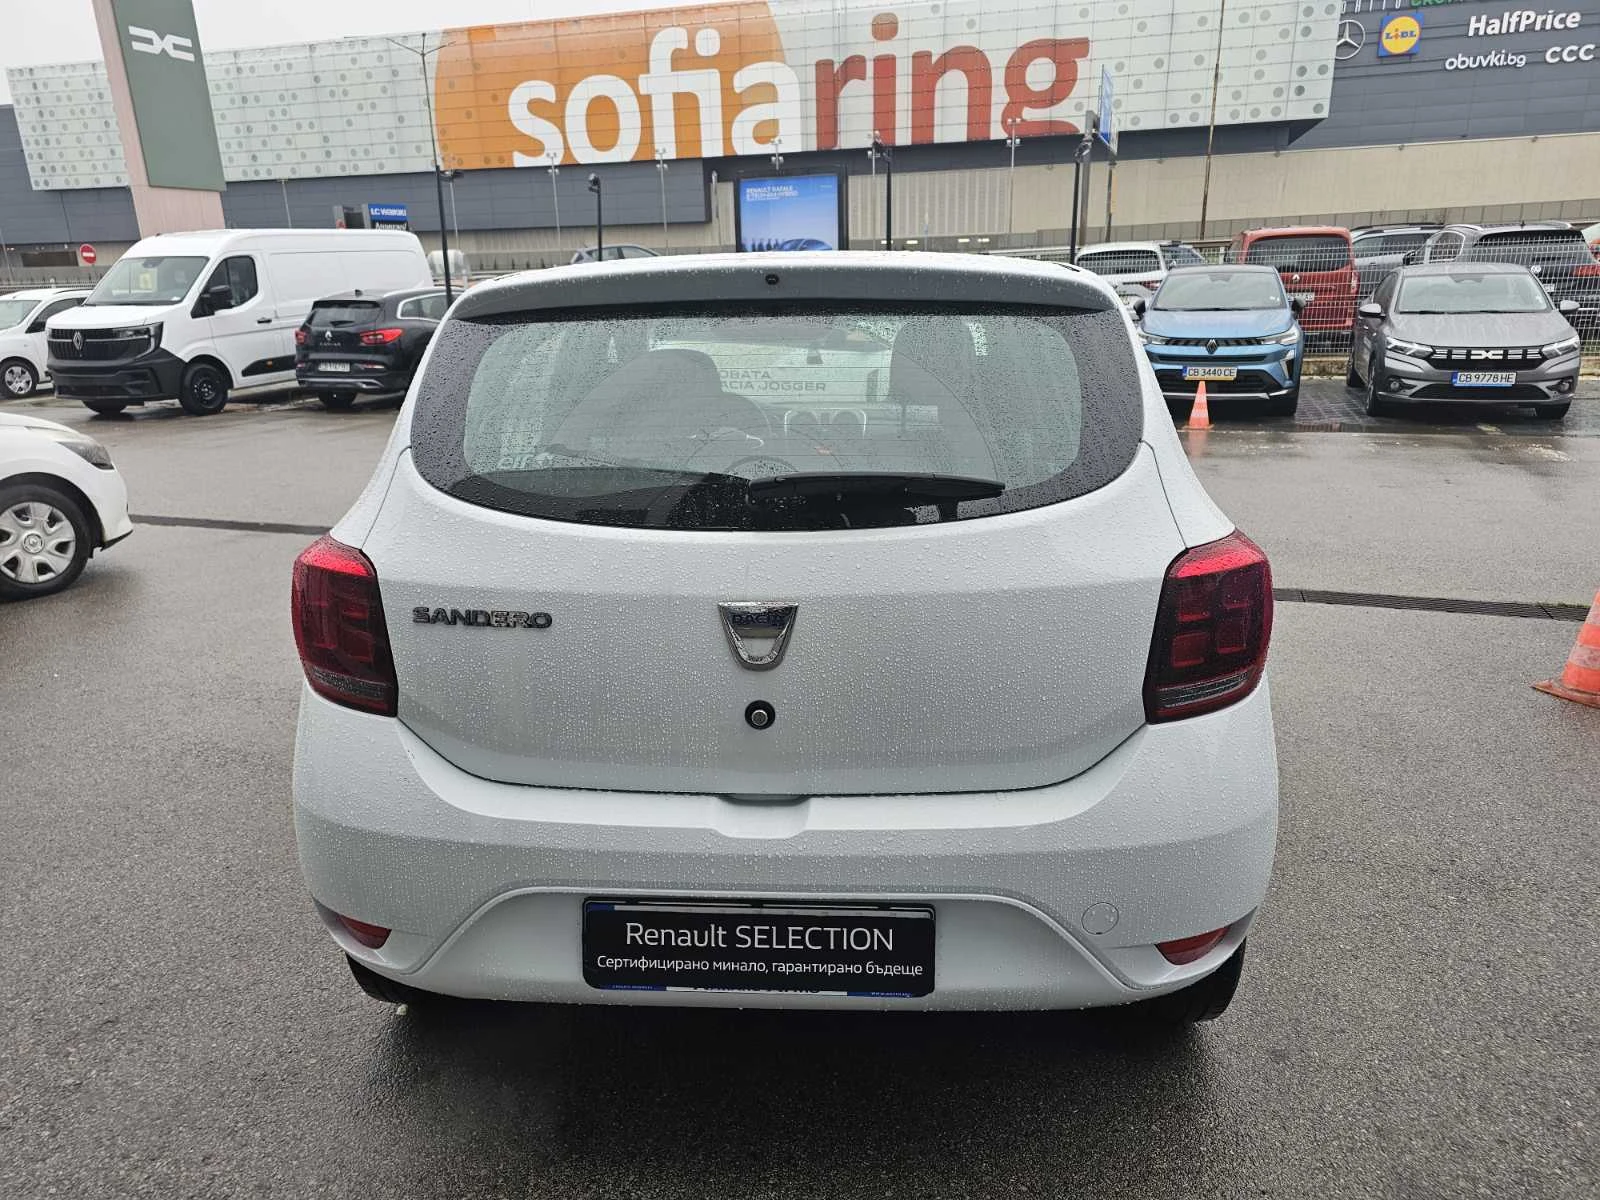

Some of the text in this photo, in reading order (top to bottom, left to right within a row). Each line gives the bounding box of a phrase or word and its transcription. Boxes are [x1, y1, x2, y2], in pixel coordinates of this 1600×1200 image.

[1468, 10, 1582, 37] HalfPrice
[1445, 50, 1527, 71] obuvki.bg
[1545, 44, 1596, 63] CCC
[758, 381, 827, 392] JOGGER
[1459, 373, 1515, 383] CB 9778 HE
[412, 606, 553, 629] SANDERO
[625, 921, 894, 951] Renault SELECTION
[597, 955, 924, 976] Сертифицирано минало, гарантирано бъдеще
